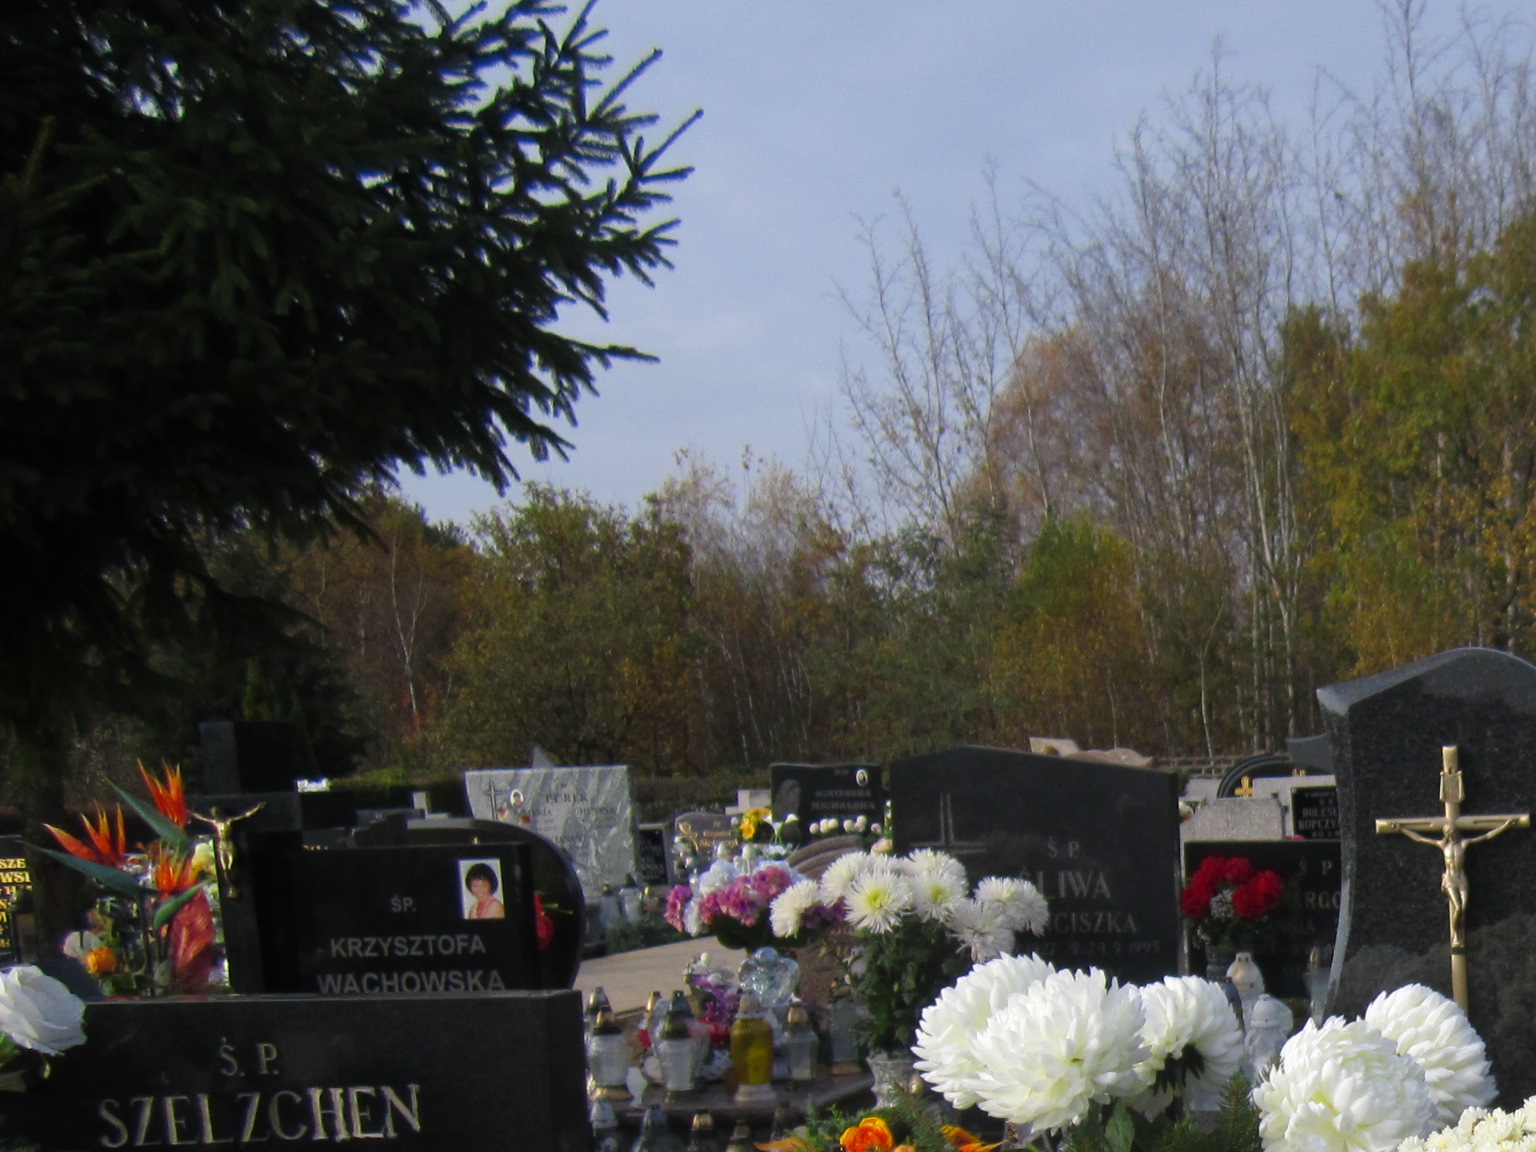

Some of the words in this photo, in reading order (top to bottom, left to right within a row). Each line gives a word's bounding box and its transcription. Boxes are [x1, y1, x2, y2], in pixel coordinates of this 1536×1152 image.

[1019, 866, 1112, 899] LIWA
[1046, 911, 1139, 935] CISZKA
[329, 934, 487, 958] KRZYSZTOFA
[316, 969, 506, 994] WACHOWSKA
[99, 1083, 422, 1149] SZELZCHEN
